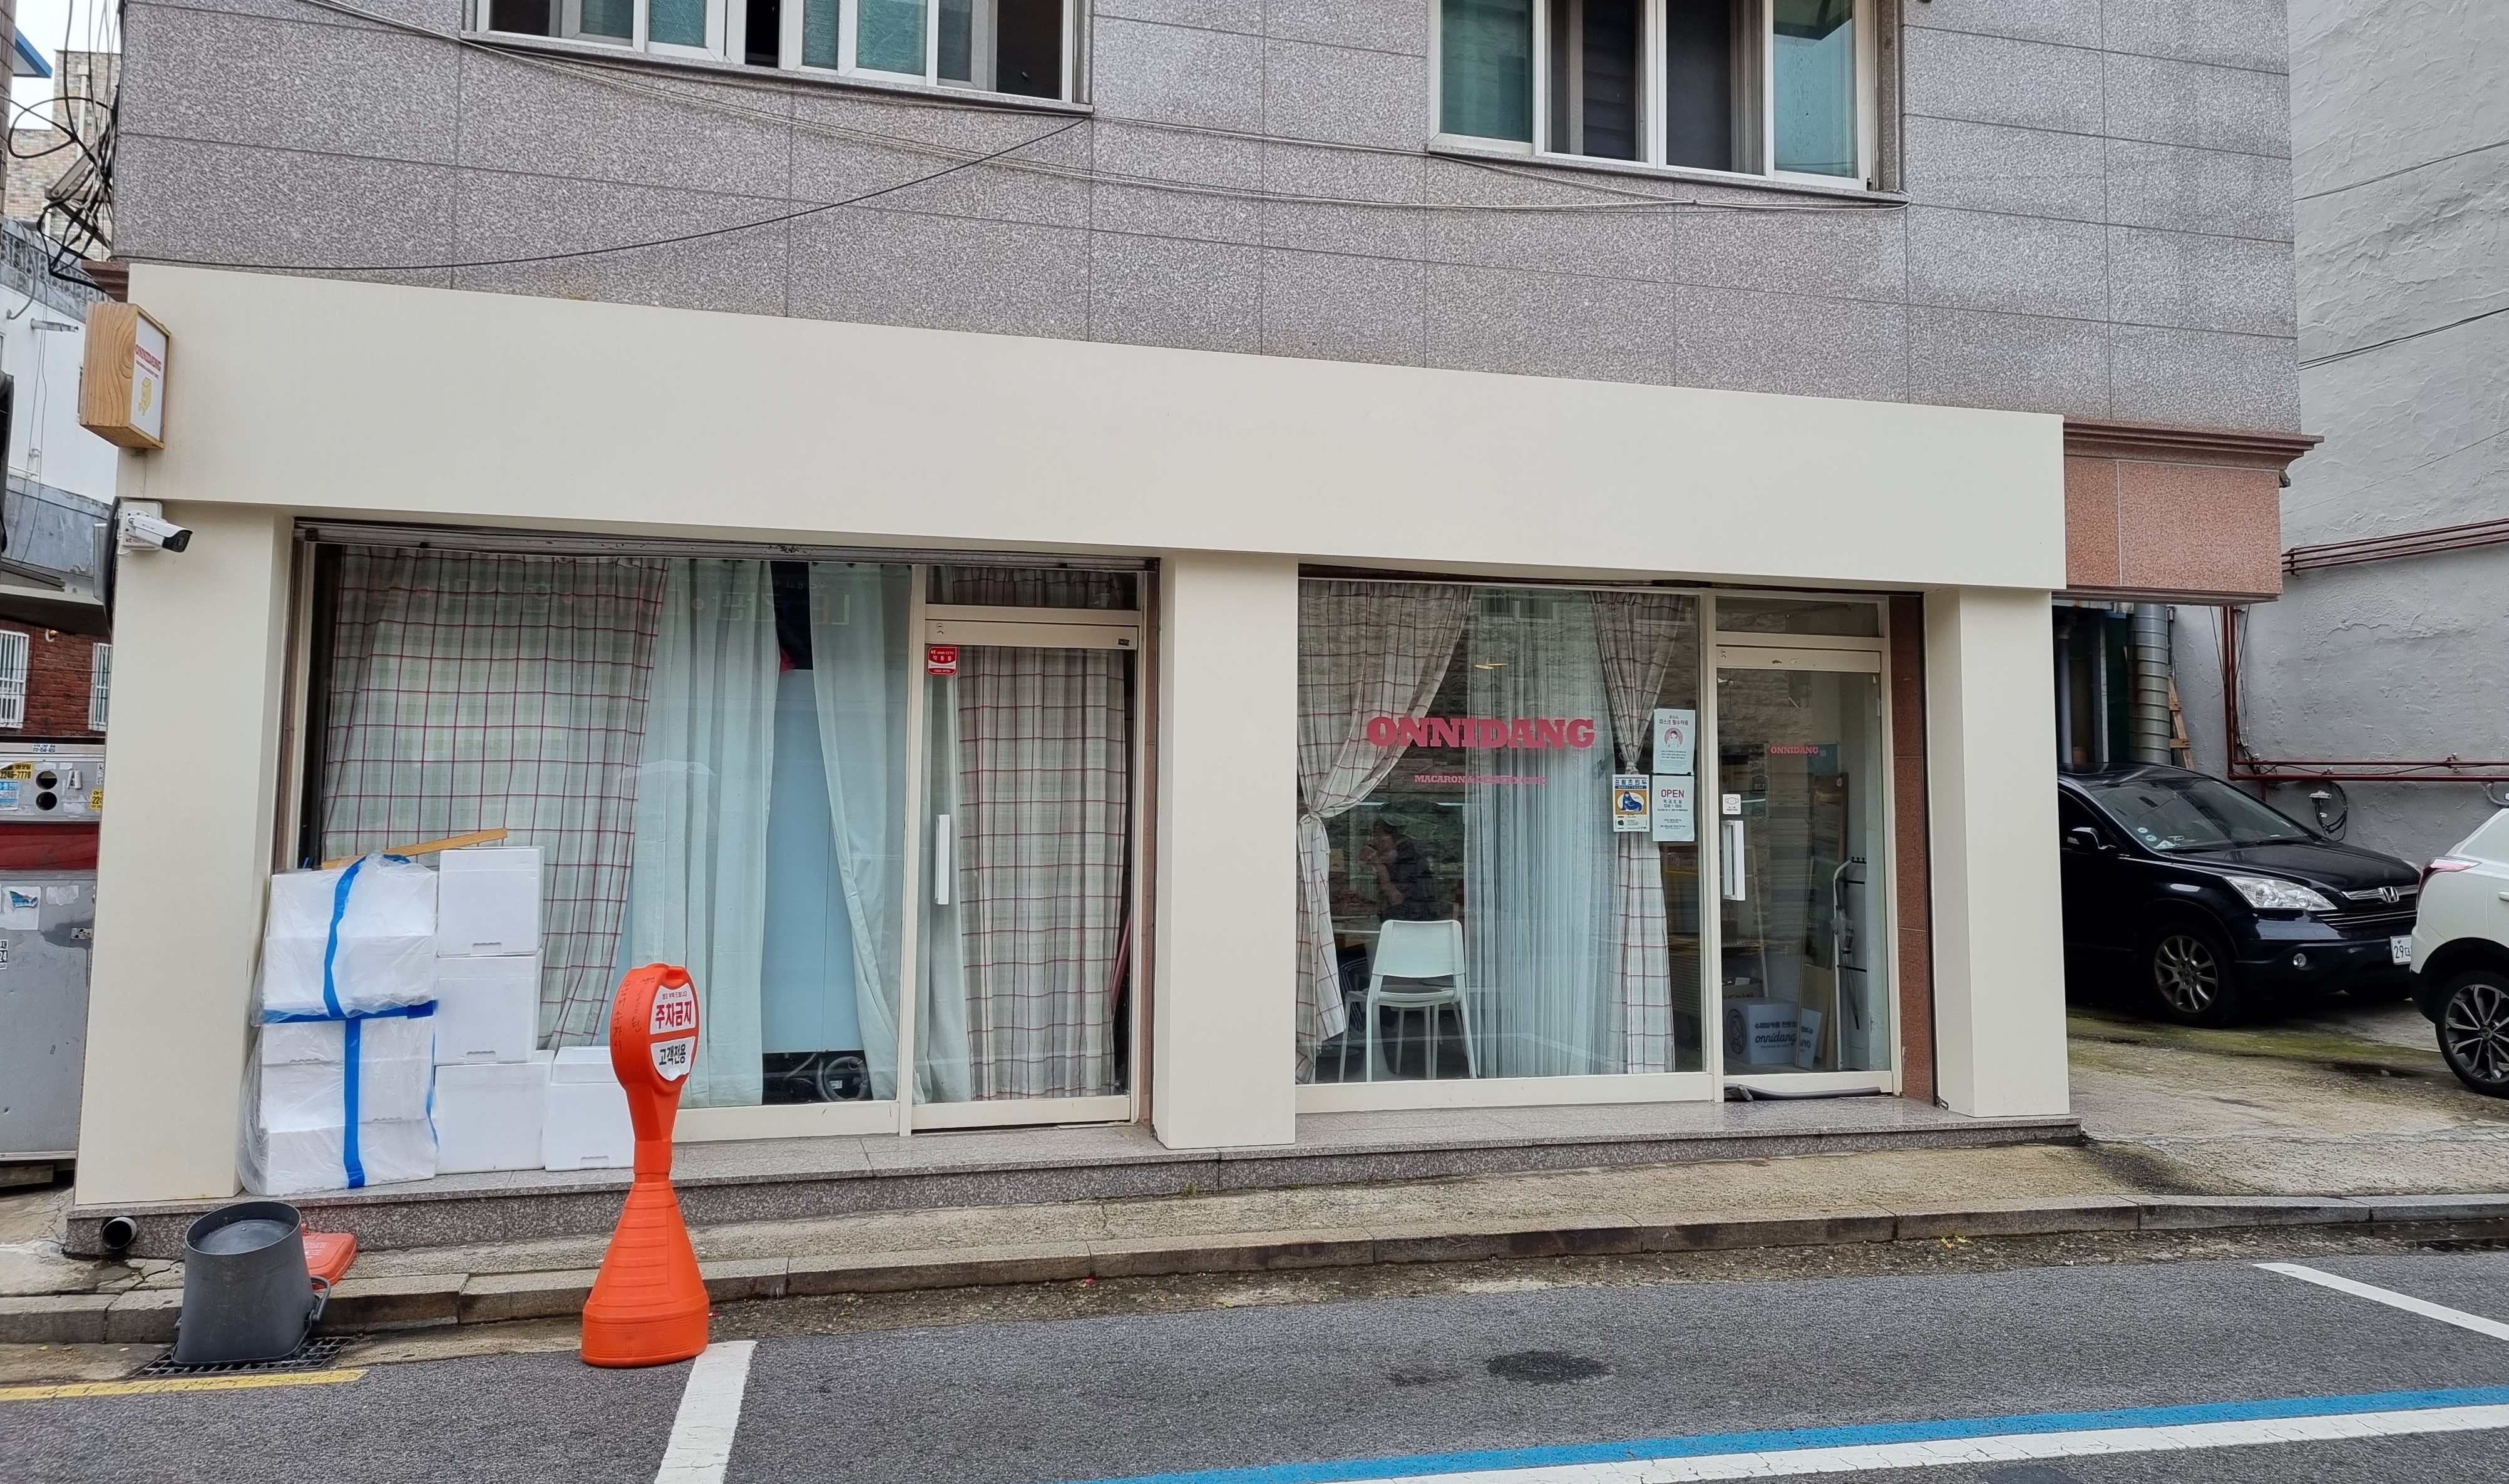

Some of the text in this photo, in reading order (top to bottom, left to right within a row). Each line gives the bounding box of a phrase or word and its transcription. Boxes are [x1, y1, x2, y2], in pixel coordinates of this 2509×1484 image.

[1367, 716, 1596, 749] ONNIDANG
[1770, 746, 1819, 754] ONNIDANG
[1415, 775, 1465, 784] MACARON
[1661, 789, 1685, 798] OPEN
[655, 1000, 692, 1029] 주차금지
[1755, 1031, 1797, 1046] onnidang
[659, 1044, 686, 1066] 고객전용
